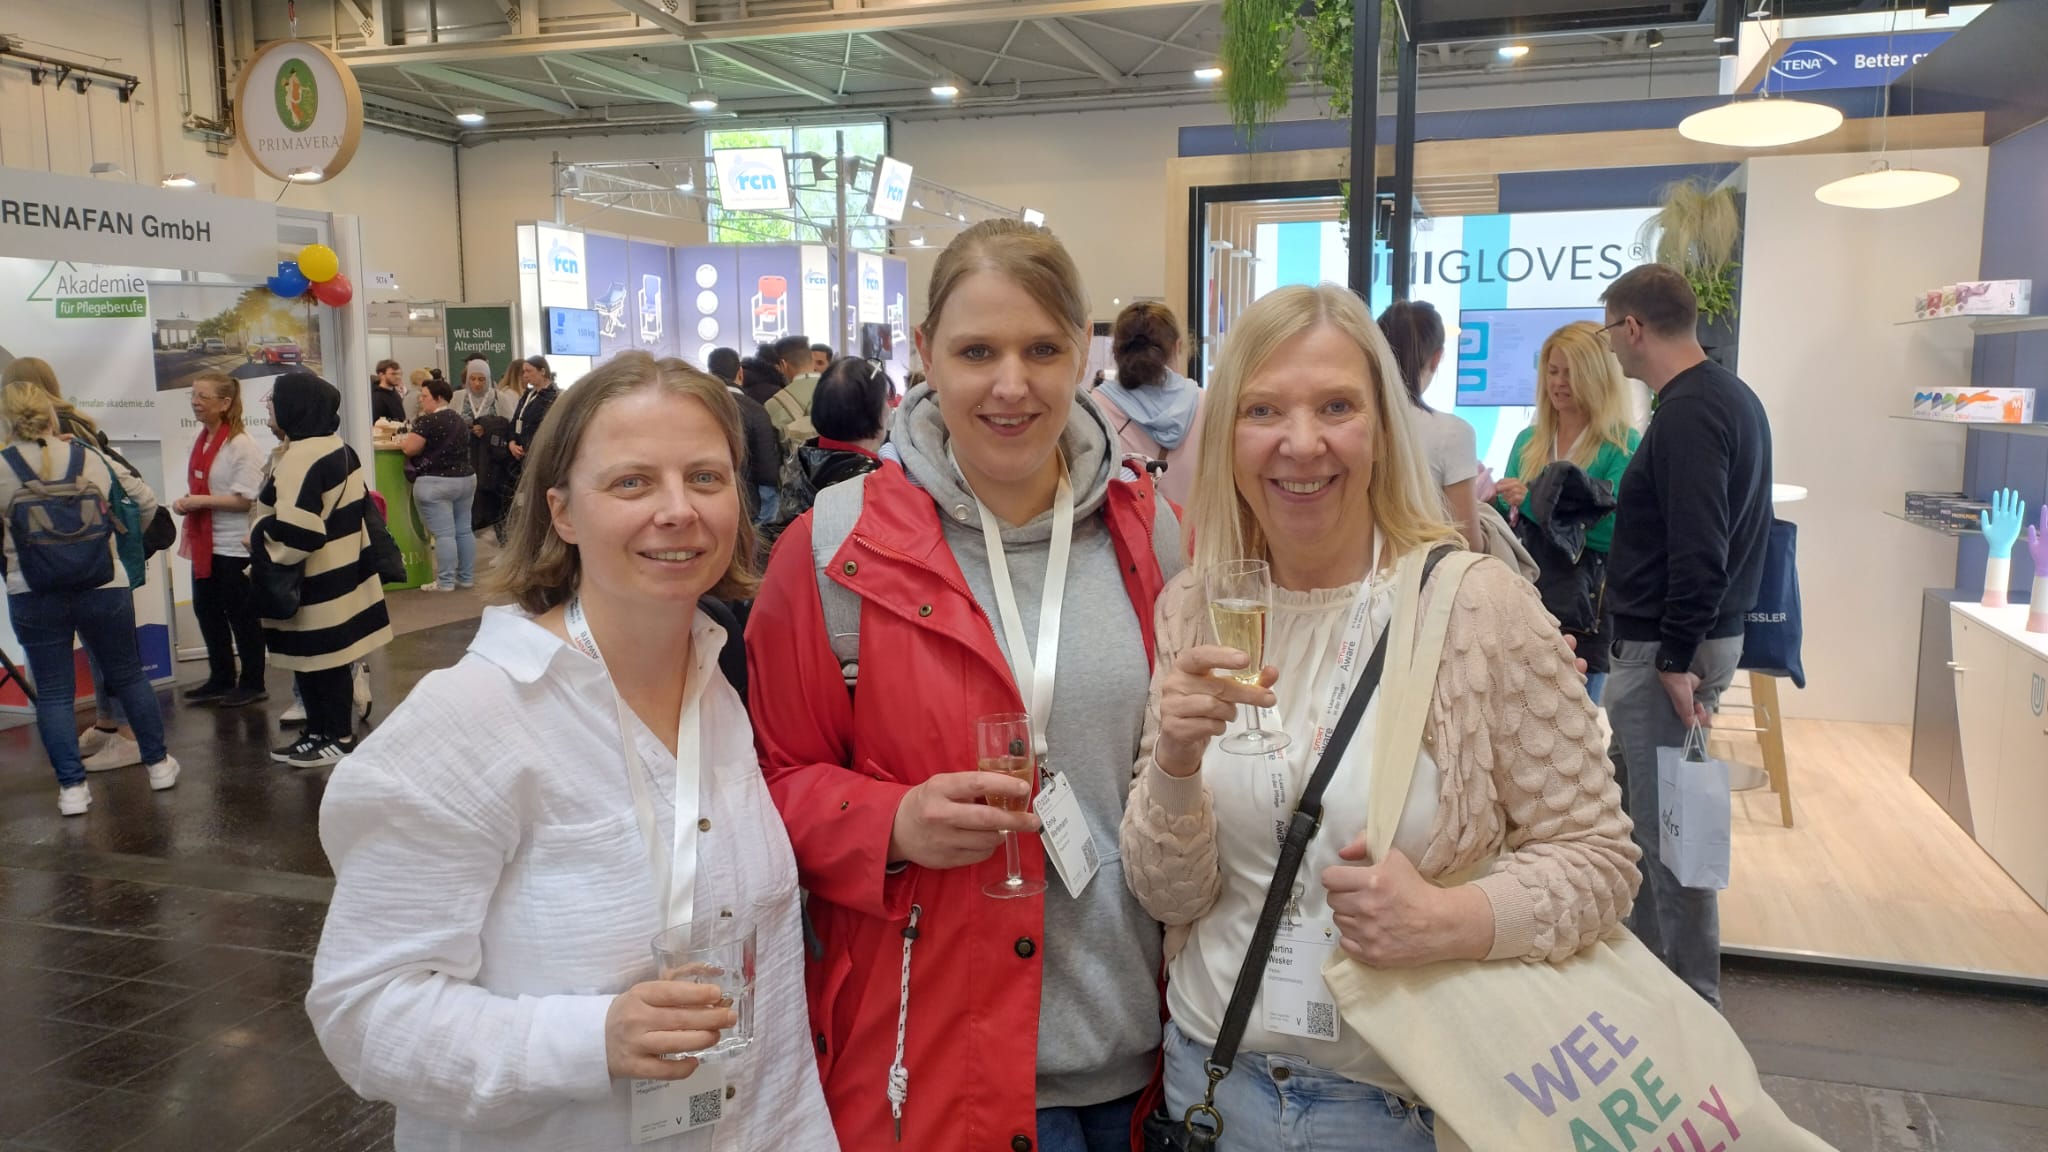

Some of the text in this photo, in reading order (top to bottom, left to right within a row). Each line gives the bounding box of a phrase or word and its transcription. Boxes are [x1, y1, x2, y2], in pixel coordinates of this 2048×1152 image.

[1782, 58, 1822, 71] TENA
[1854, 53, 1908, 69] Better
[259, 135, 340, 152] PRIMAVERA
[737, 174, 777, 191] rcn
[886, 184, 903, 201] rcn
[1, 199, 212, 243] RENAFAN GmbH
[554, 256, 579, 274] rcn
[57, 273, 145, 296] Akademie
[808, 276, 826, 285] rcn
[866, 277, 880, 291] rcn
[60, 300, 145, 317] für Pflegeberufe
[453, 327, 493, 339] Wir Sind
[454, 340, 506, 353] Altenpflege
[180, 417, 197, 429] Ihr
[1340, 640, 1356, 672] Aware
[1503, 1010, 1640, 1118] WEE
[1568, 1056, 1682, 1152] ARE
[676, 1116, 682, 1125] V
